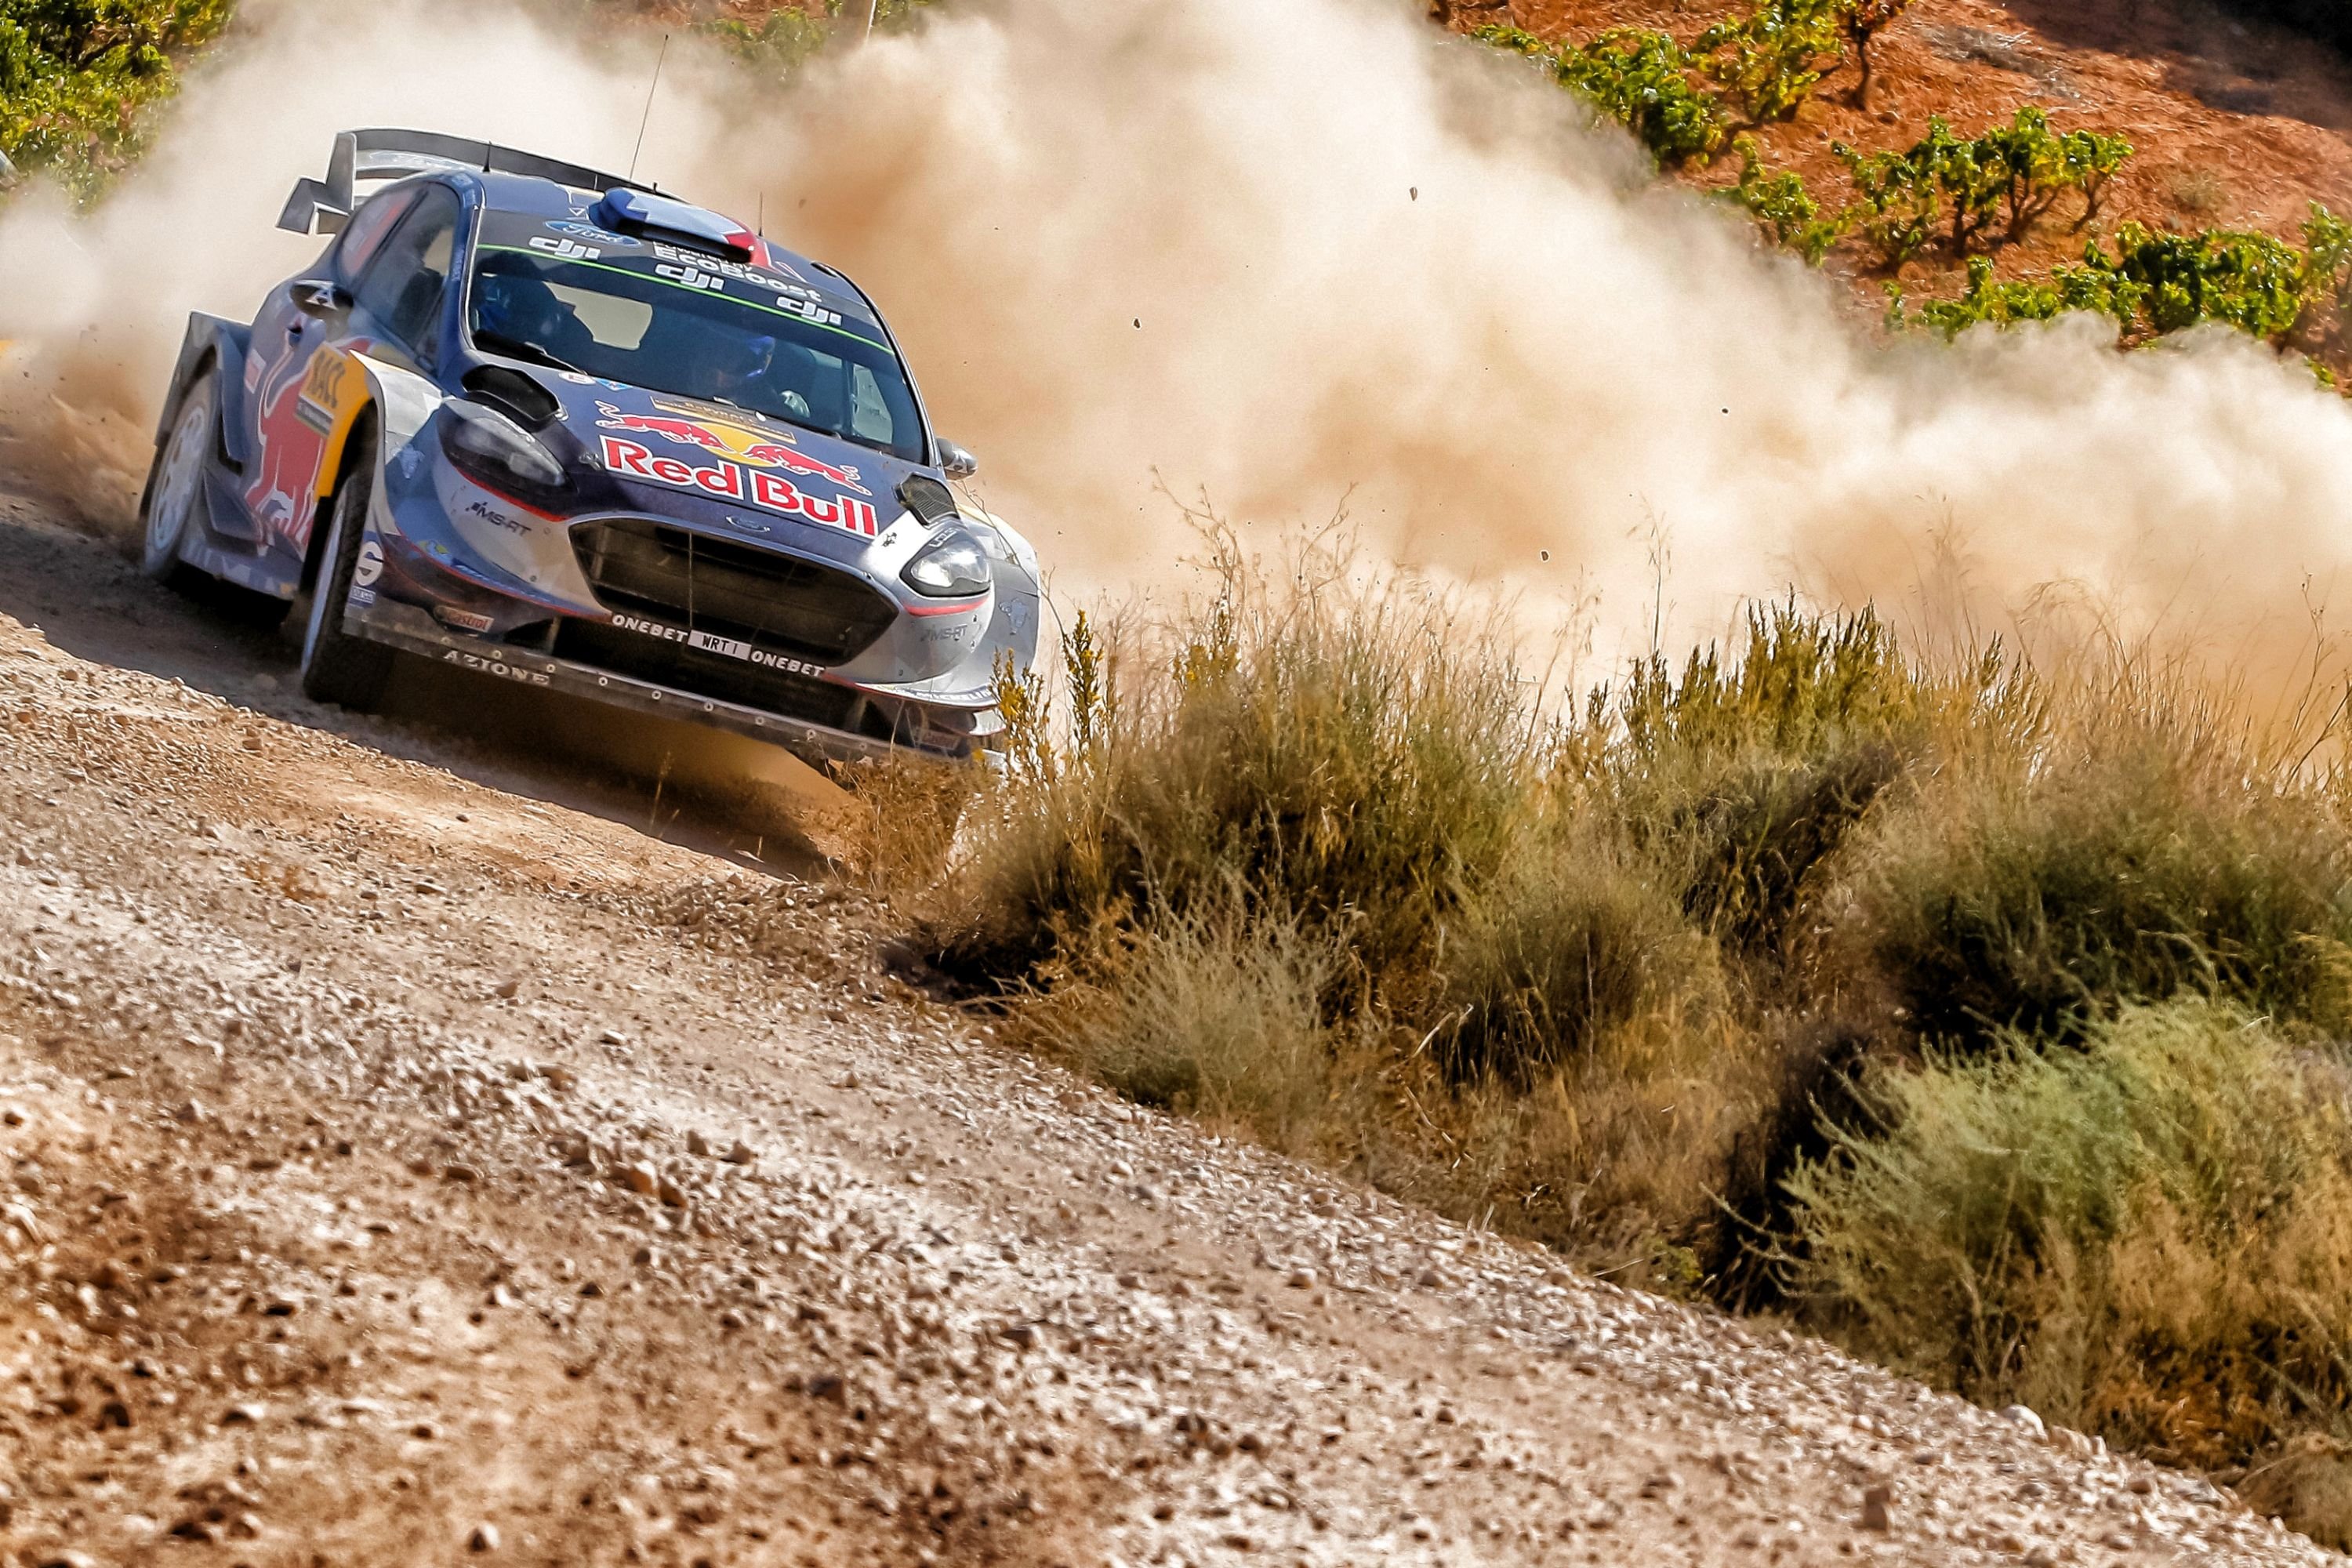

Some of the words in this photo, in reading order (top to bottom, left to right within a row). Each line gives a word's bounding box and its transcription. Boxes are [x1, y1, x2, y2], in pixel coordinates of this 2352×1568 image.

[528, 236, 602, 260] dji
[655, 263, 724, 291] dji
[776, 295, 842, 327] dji
[601, 436, 742, 499] Red
[753, 471, 877, 537] Bull
[612, 614, 688, 643] ONEBET
[702, 635, 729, 653] WRT
[751, 651, 825, 677] ONEBET
